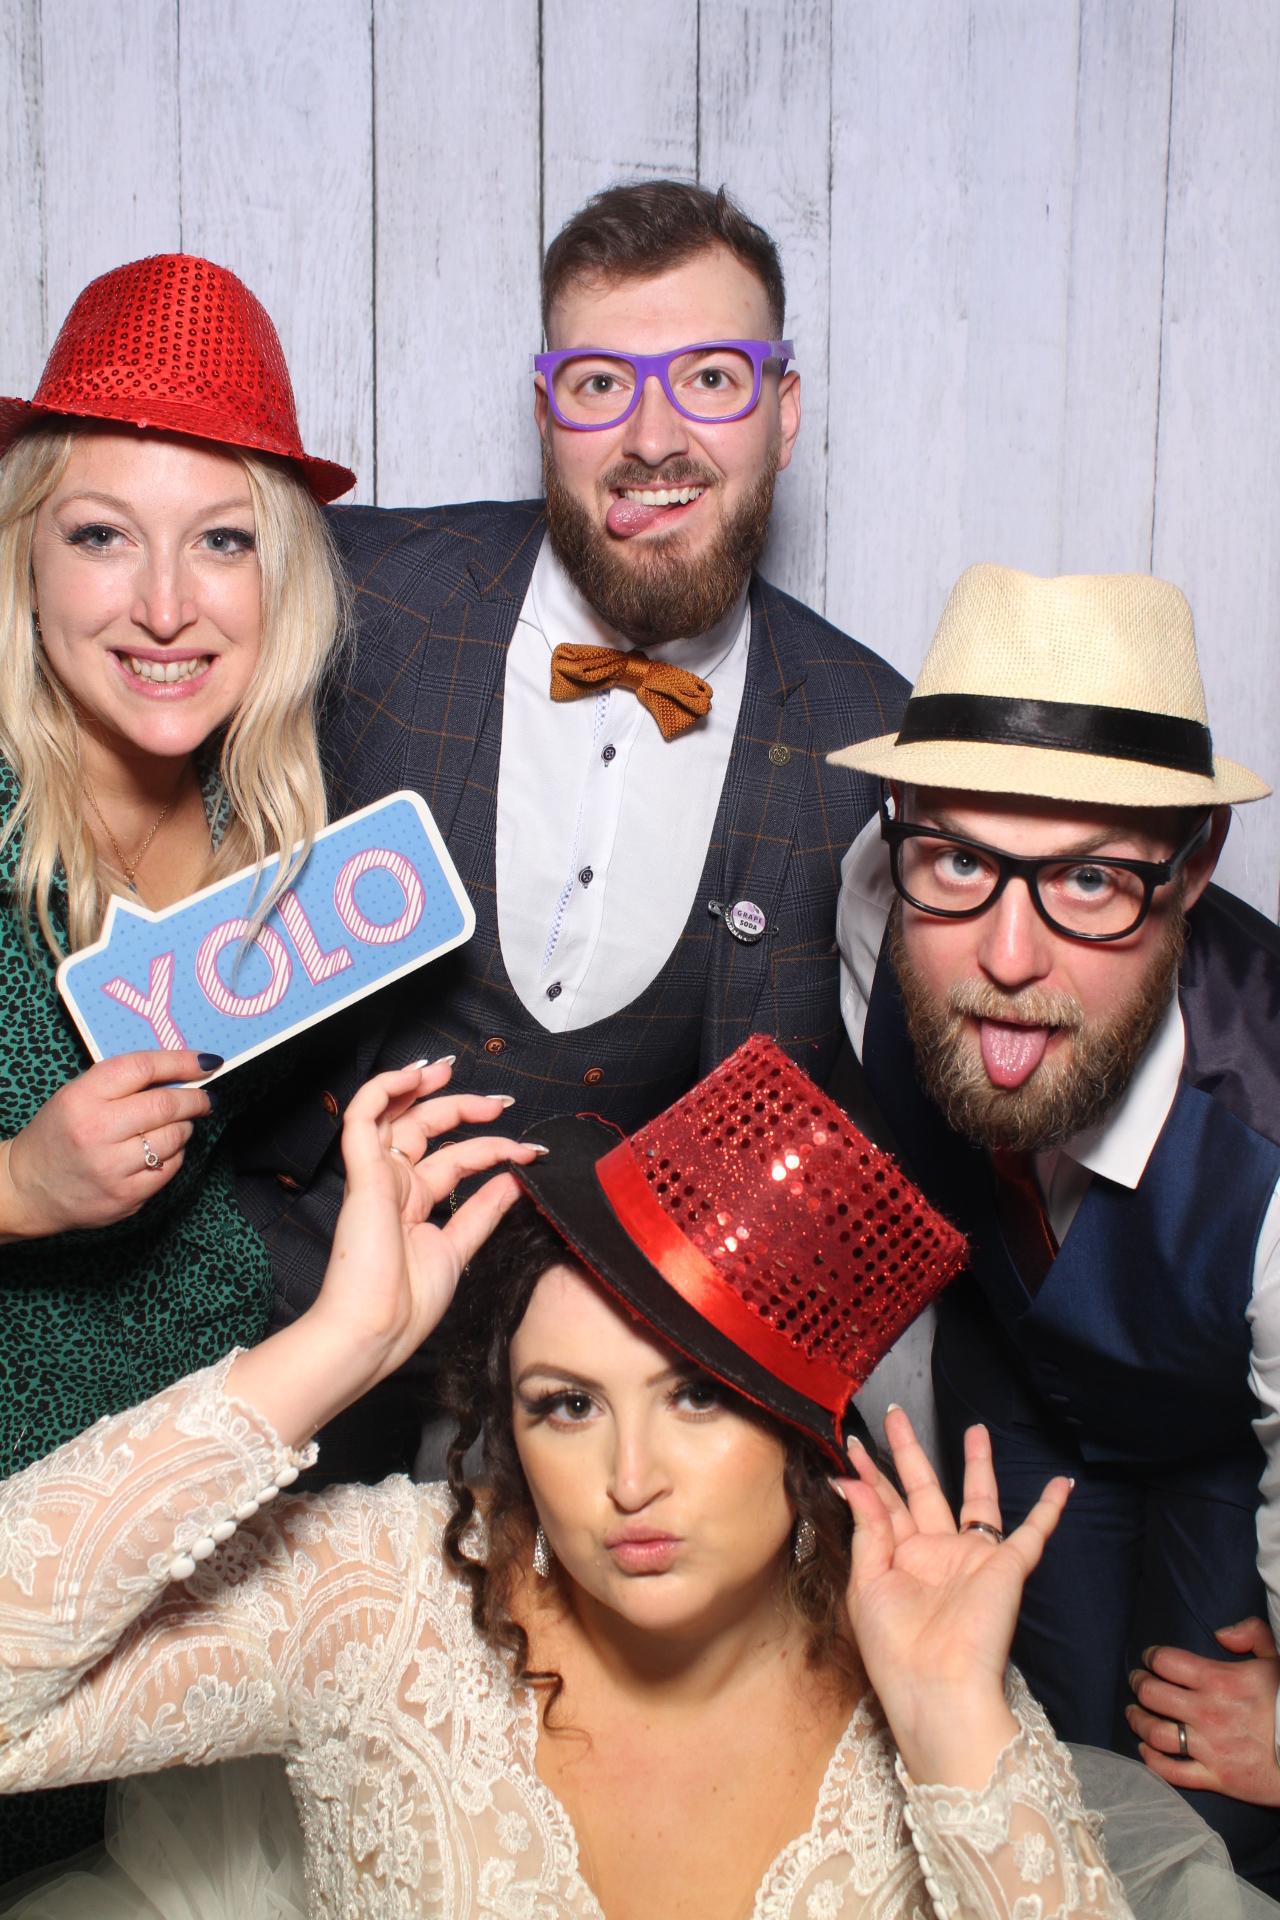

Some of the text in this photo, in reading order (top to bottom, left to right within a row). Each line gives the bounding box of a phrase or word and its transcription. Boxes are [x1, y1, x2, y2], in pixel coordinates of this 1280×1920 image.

[737, 910, 762, 924] GRAPE
[740, 919, 758, 930] SODA
[102, 848, 426, 1051] YOLO
